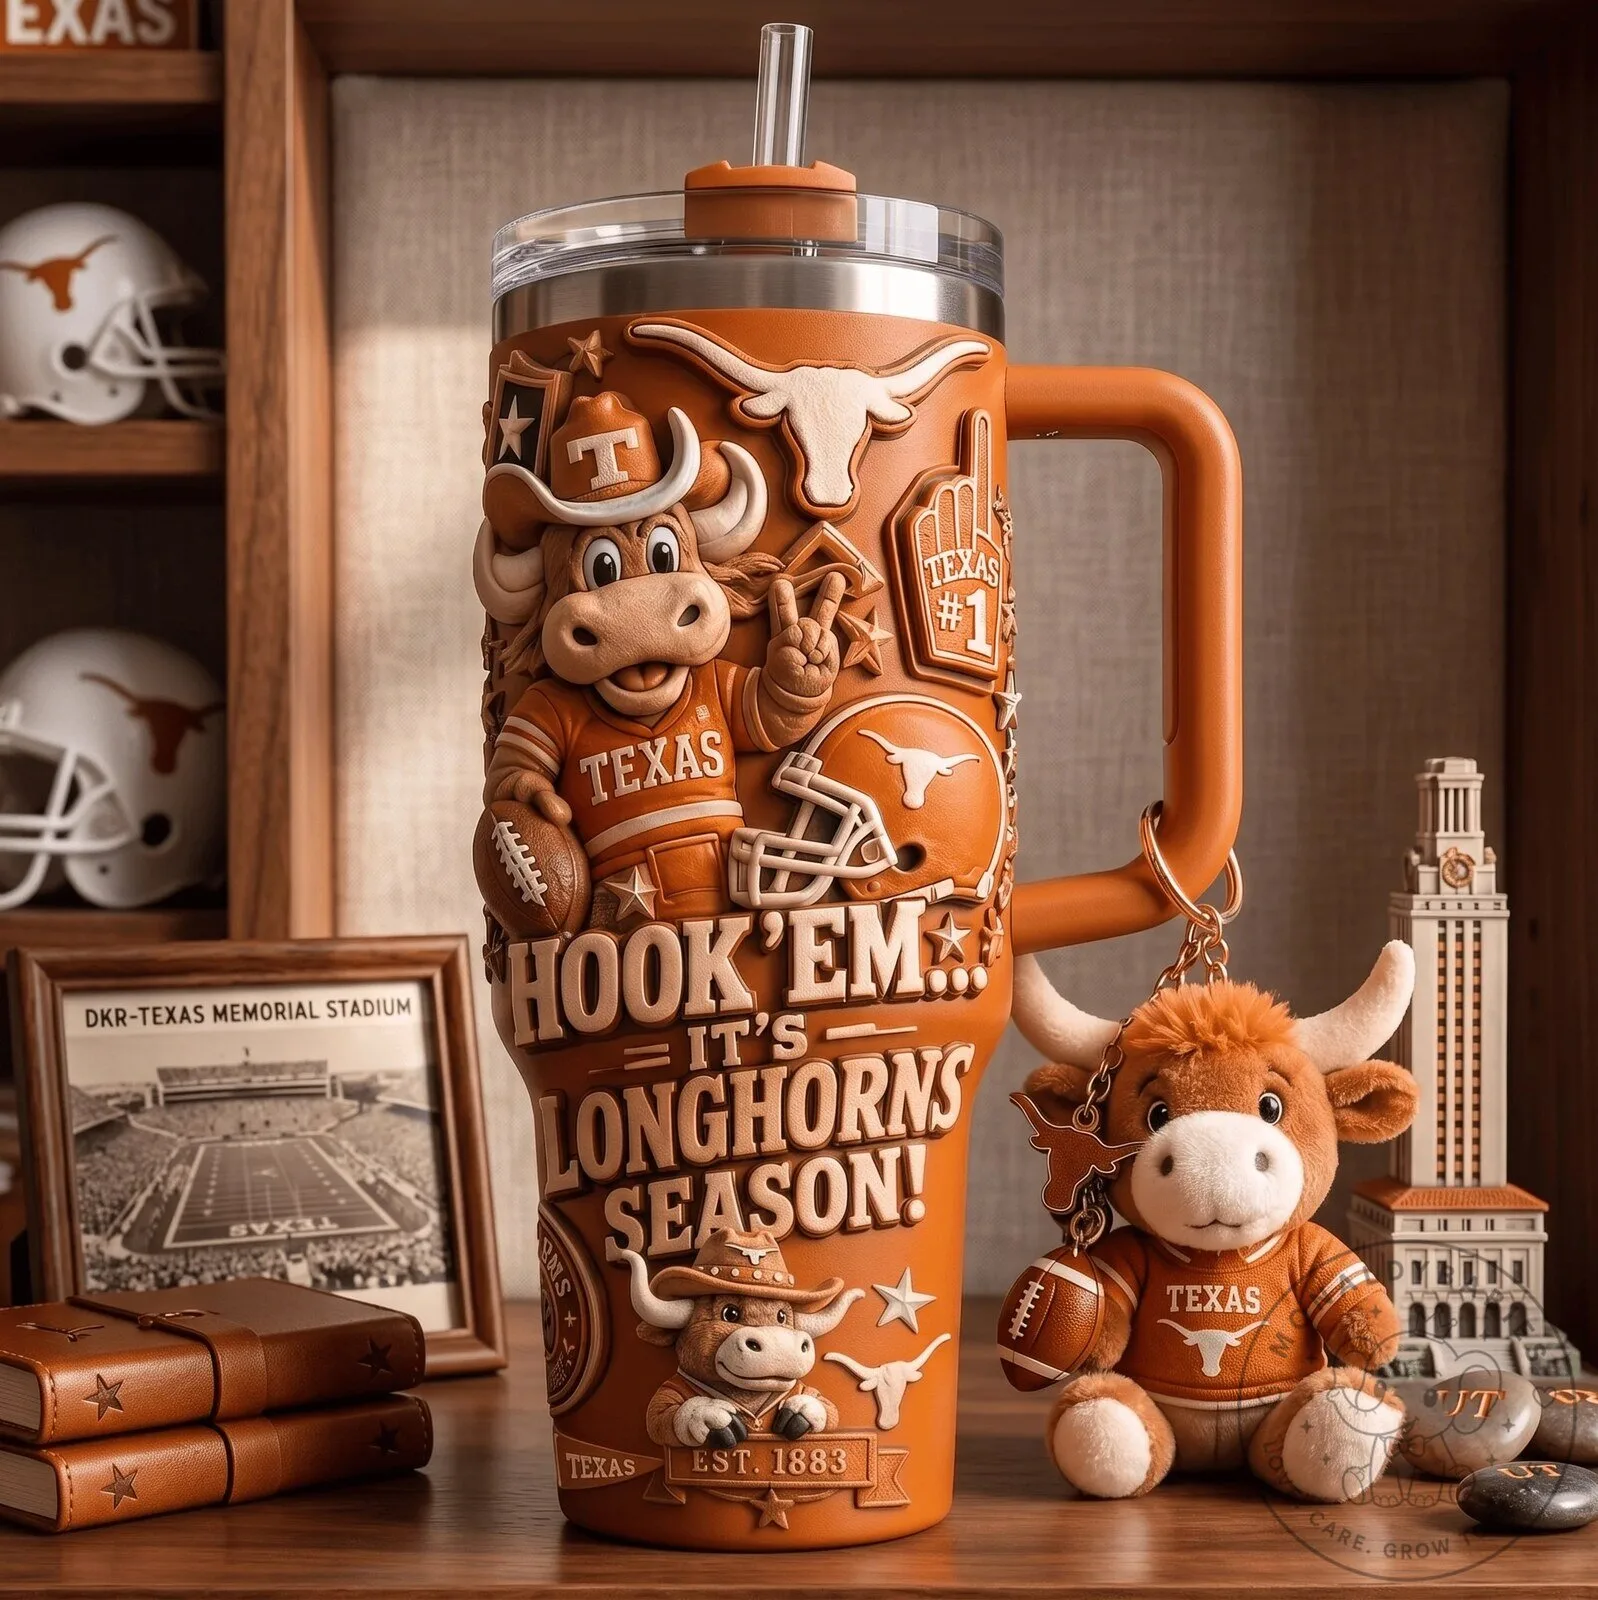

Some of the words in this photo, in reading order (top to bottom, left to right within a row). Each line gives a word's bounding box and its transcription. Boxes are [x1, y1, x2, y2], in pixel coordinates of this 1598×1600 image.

[567, 427, 639, 488] T
[923, 547, 1000, 588] TEXAS
[936, 588, 993, 658] #1
[579, 729, 725, 807] TEXAS
[507, 914, 758, 1046] HOOK
[85, 1004, 205, 1028] DKR-TEXAS
[212, 1001, 321, 1024] MEMORIAL
[326, 997, 413, 1019] STADIUM
[687, 1013, 809, 1072] IT'S
[539, 1042, 976, 1195] LONGHORNS
[604, 1144, 928, 1262] SEASON!
[1166, 1284, 1261, 1315] TEXAS
[1436, 1389, 1508, 1419] UT
[565, 1452, 637, 1480] TEXAS
[692, 1448, 760, 1475] EST.
[773, 1447, 849, 1476] 1883
[1496, 1464, 1563, 1480] UT
